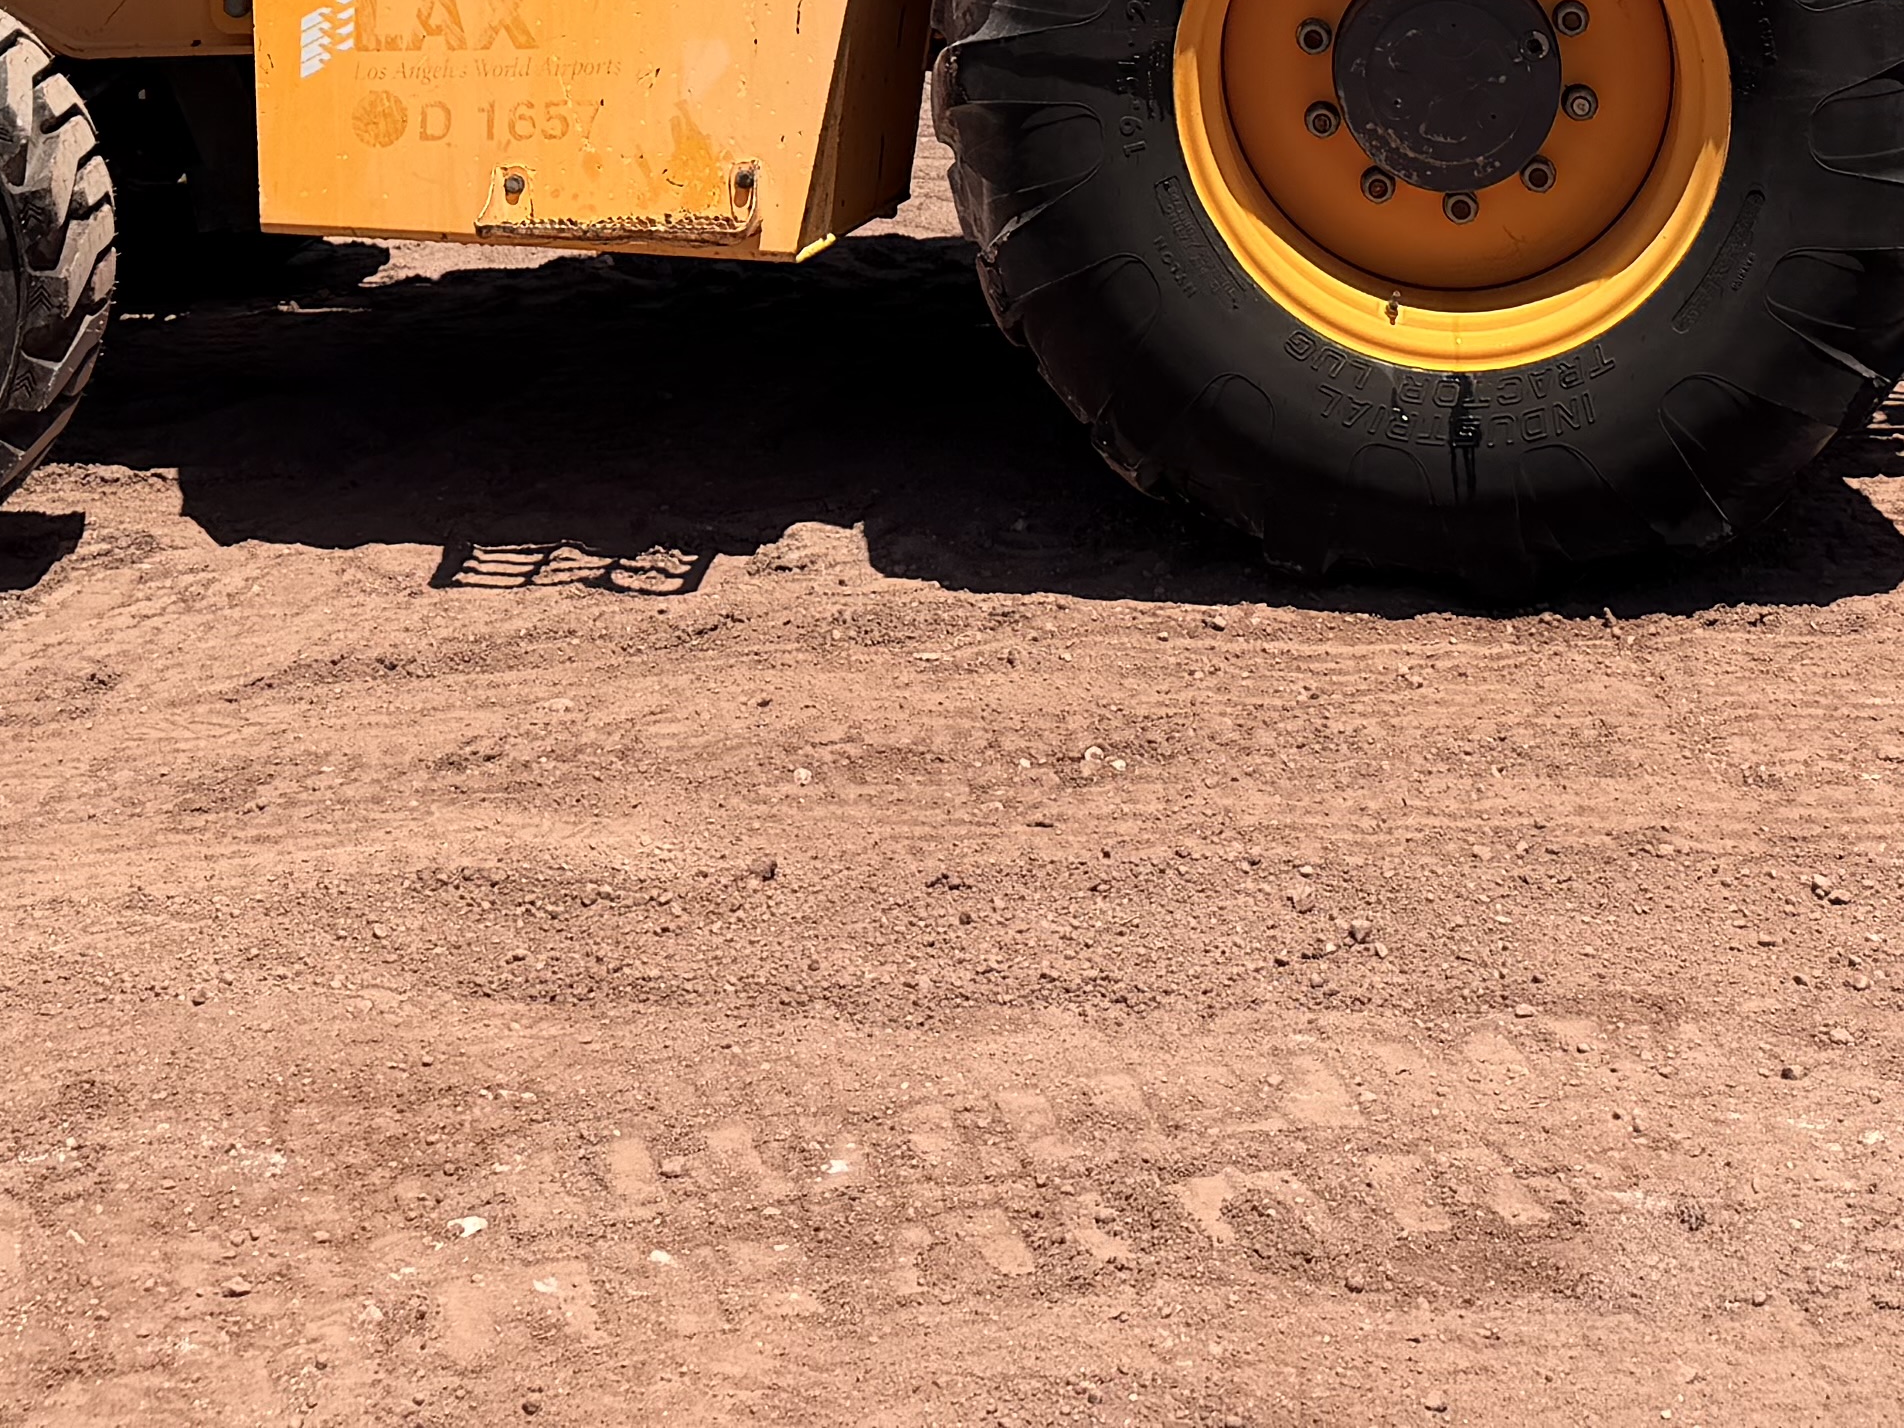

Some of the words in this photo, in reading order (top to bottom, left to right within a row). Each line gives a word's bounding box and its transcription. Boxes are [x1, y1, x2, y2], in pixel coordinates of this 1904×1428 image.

[355, 60, 387, 81] Los
[394, 58, 467, 85] Angeles
[473, 56, 532, 80] World
[543, 55, 623, 81] Airports
[477, 98, 601, 143] 1657
[1283, 329, 1378, 391] LUG
[1397, 342, 1616, 409] TRACTOR
[1318, 383, 1597, 447] INDUSTRIAL
